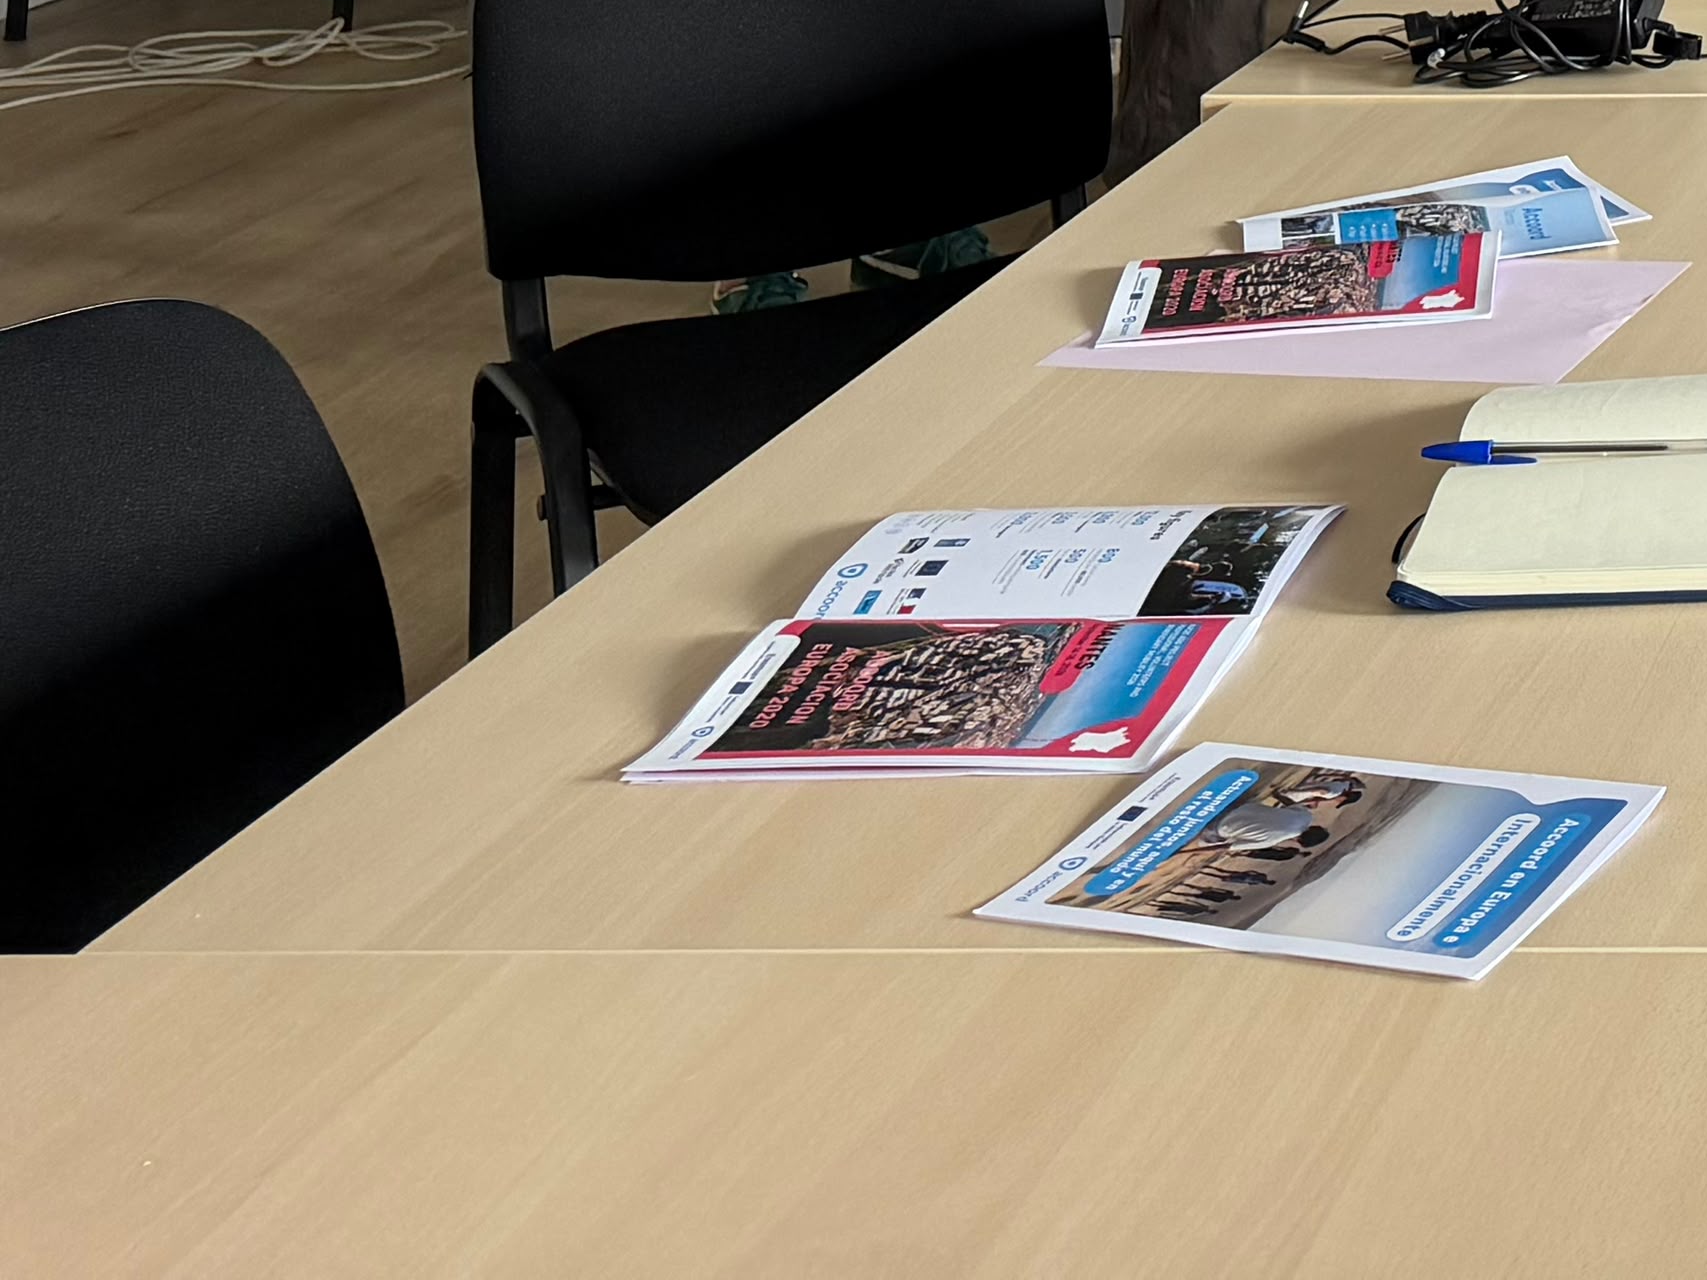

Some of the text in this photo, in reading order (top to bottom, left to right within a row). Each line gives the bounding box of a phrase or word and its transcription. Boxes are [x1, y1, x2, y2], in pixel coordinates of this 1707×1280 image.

[1523, 207, 1551, 241] Accoord
[1075, 622, 1121, 670] NANTES
[788, 642, 834, 693] EUROPA
[748, 697, 784, 729] 2020
[1197, 775, 1253, 817] Actuando
[1169, 801, 1201, 825] resto
[1148, 826, 1172, 841] del
[1156, 817, 1204, 850] juntos,
[1109, 842, 1153, 873] mundo
[1011, 870, 1069, 903] accoord
[1105, 880, 1125, 890] en
[1391, 817, 1535, 938] Internacionalmente
[1438, 817, 1585, 944] Accoord en Europa e
